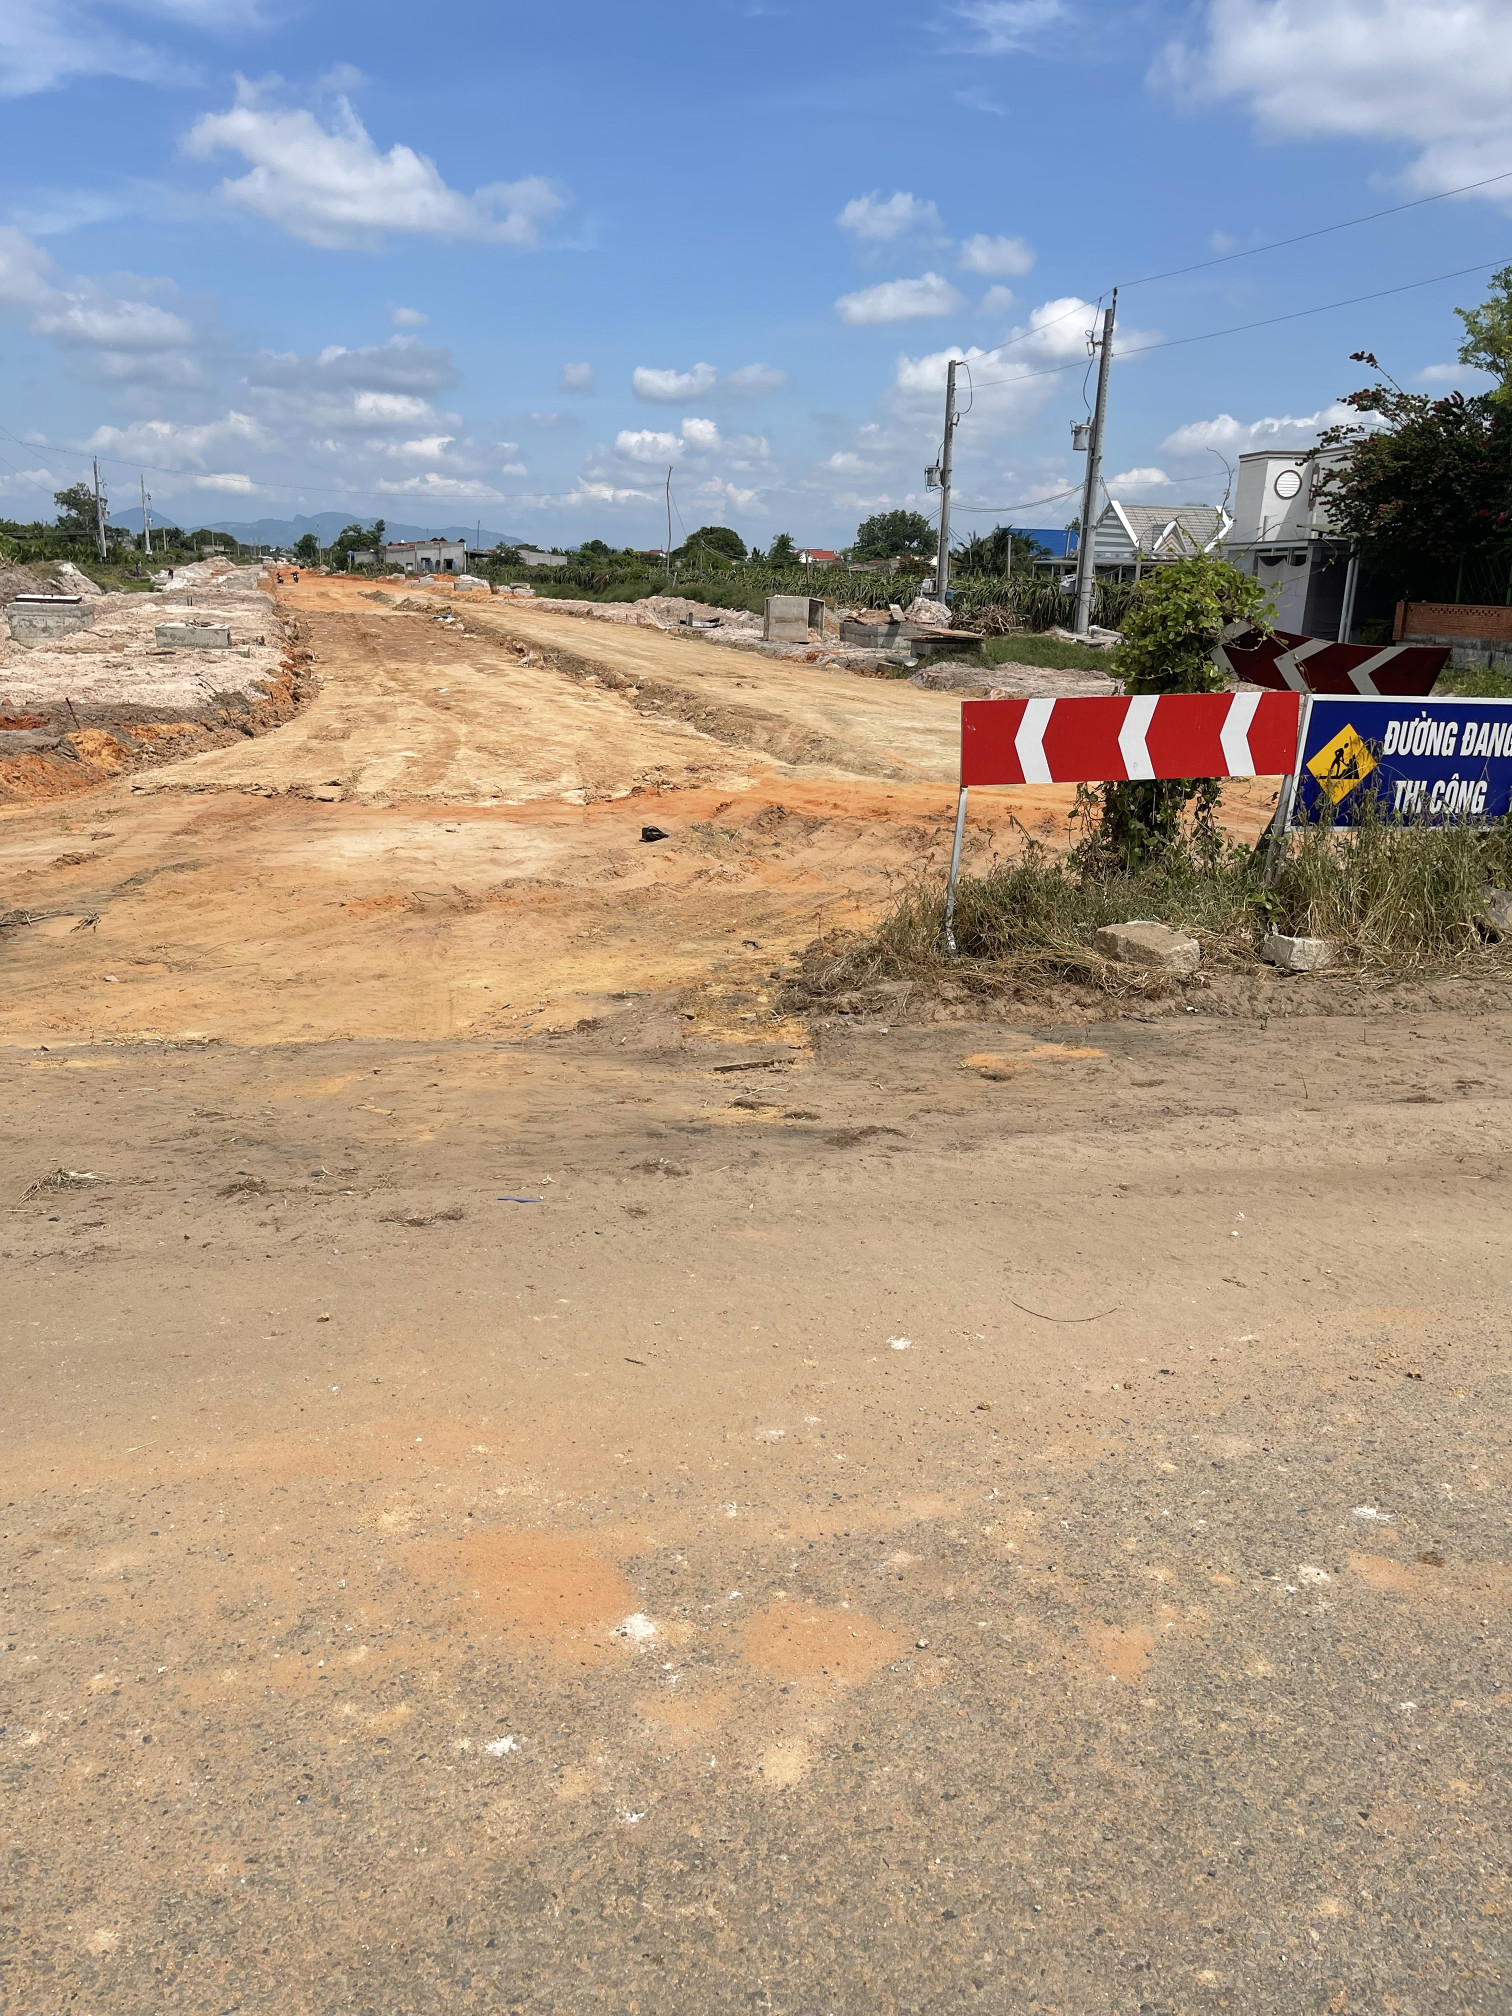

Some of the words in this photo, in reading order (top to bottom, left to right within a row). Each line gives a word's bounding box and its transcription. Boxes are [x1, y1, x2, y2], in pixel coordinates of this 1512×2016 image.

[1383, 710, 1458, 756] ĐƯỜNG
[1394, 780, 1428, 814] THI
[1430, 773, 1488, 815] CÔNG
